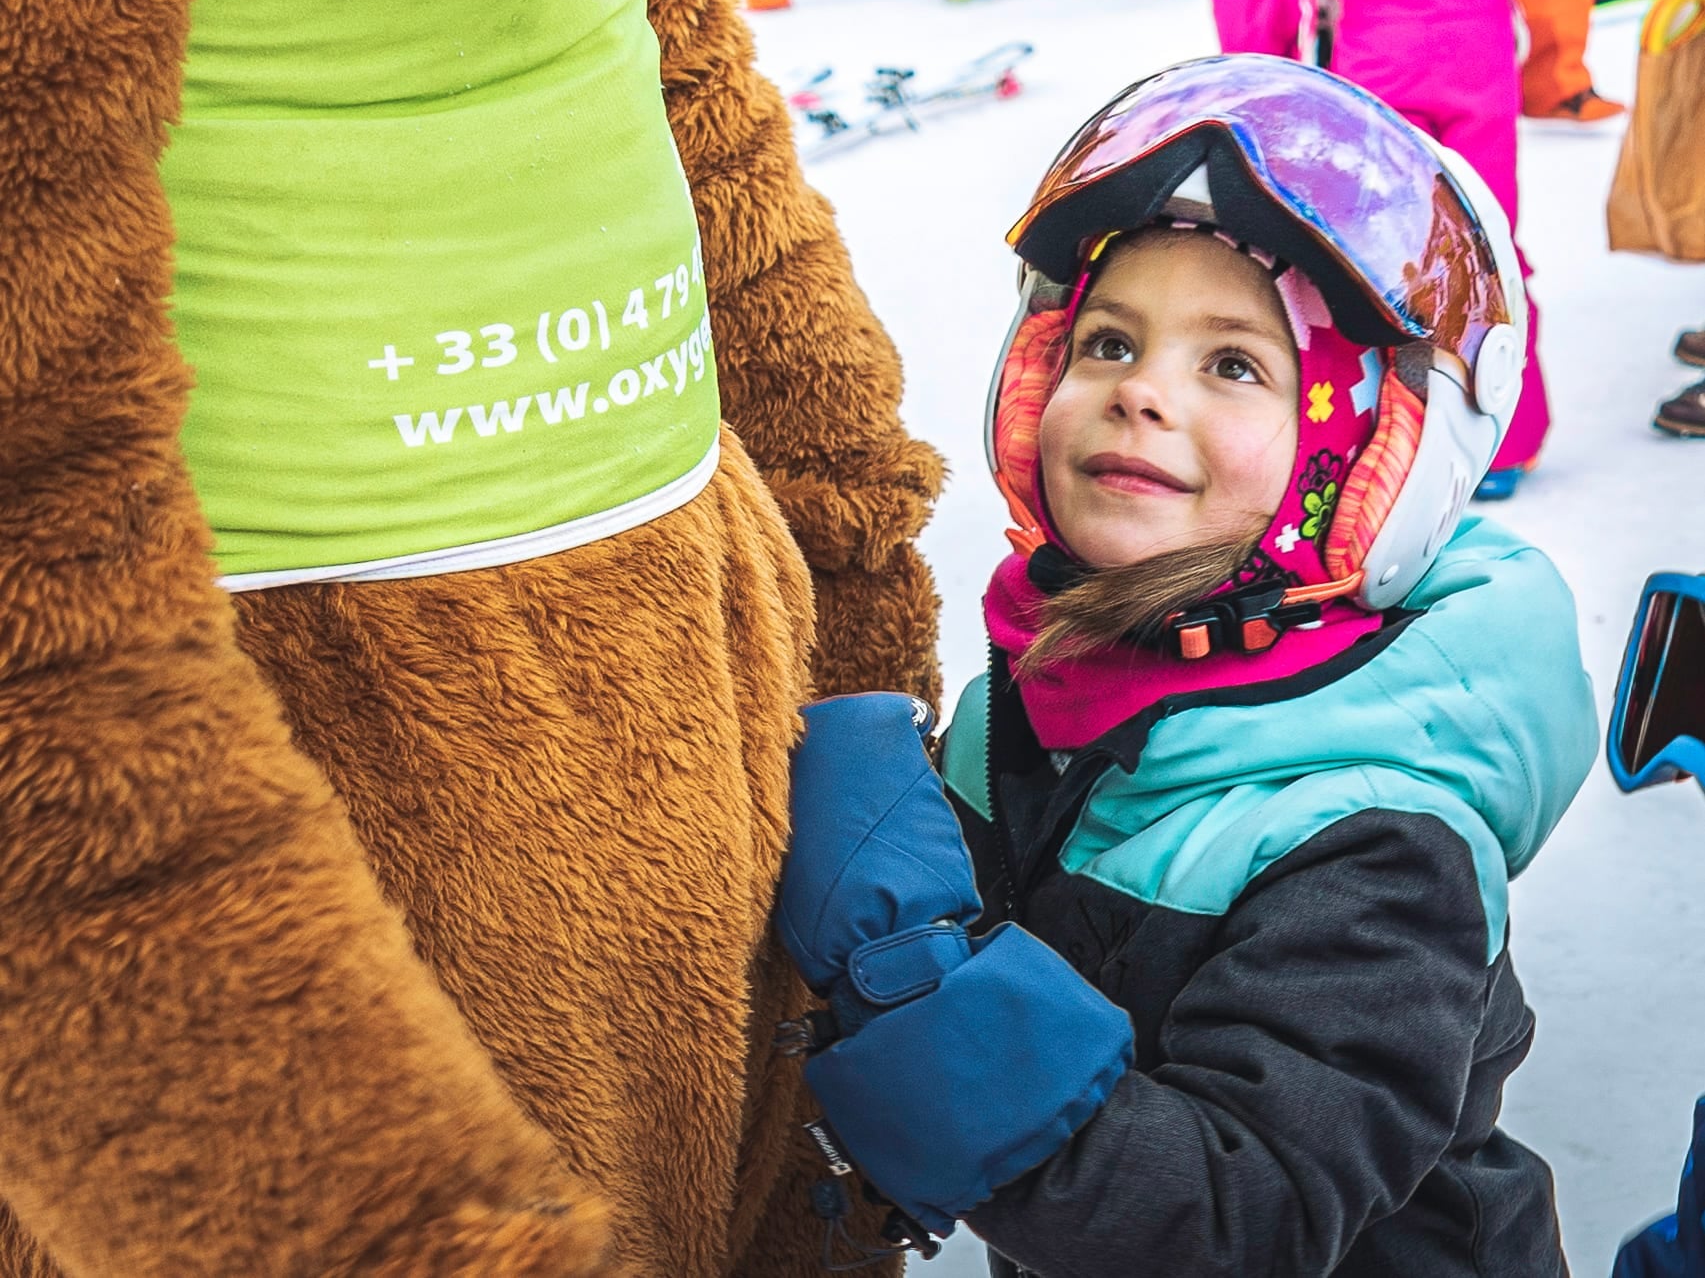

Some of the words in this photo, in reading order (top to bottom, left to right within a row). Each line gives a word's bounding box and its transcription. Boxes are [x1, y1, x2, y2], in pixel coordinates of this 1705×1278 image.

[435, 323, 518, 375] 33
[536, 300, 610, 363] (0)
[622, 288, 649, 330] 4
[655, 264, 689, 319] 79
